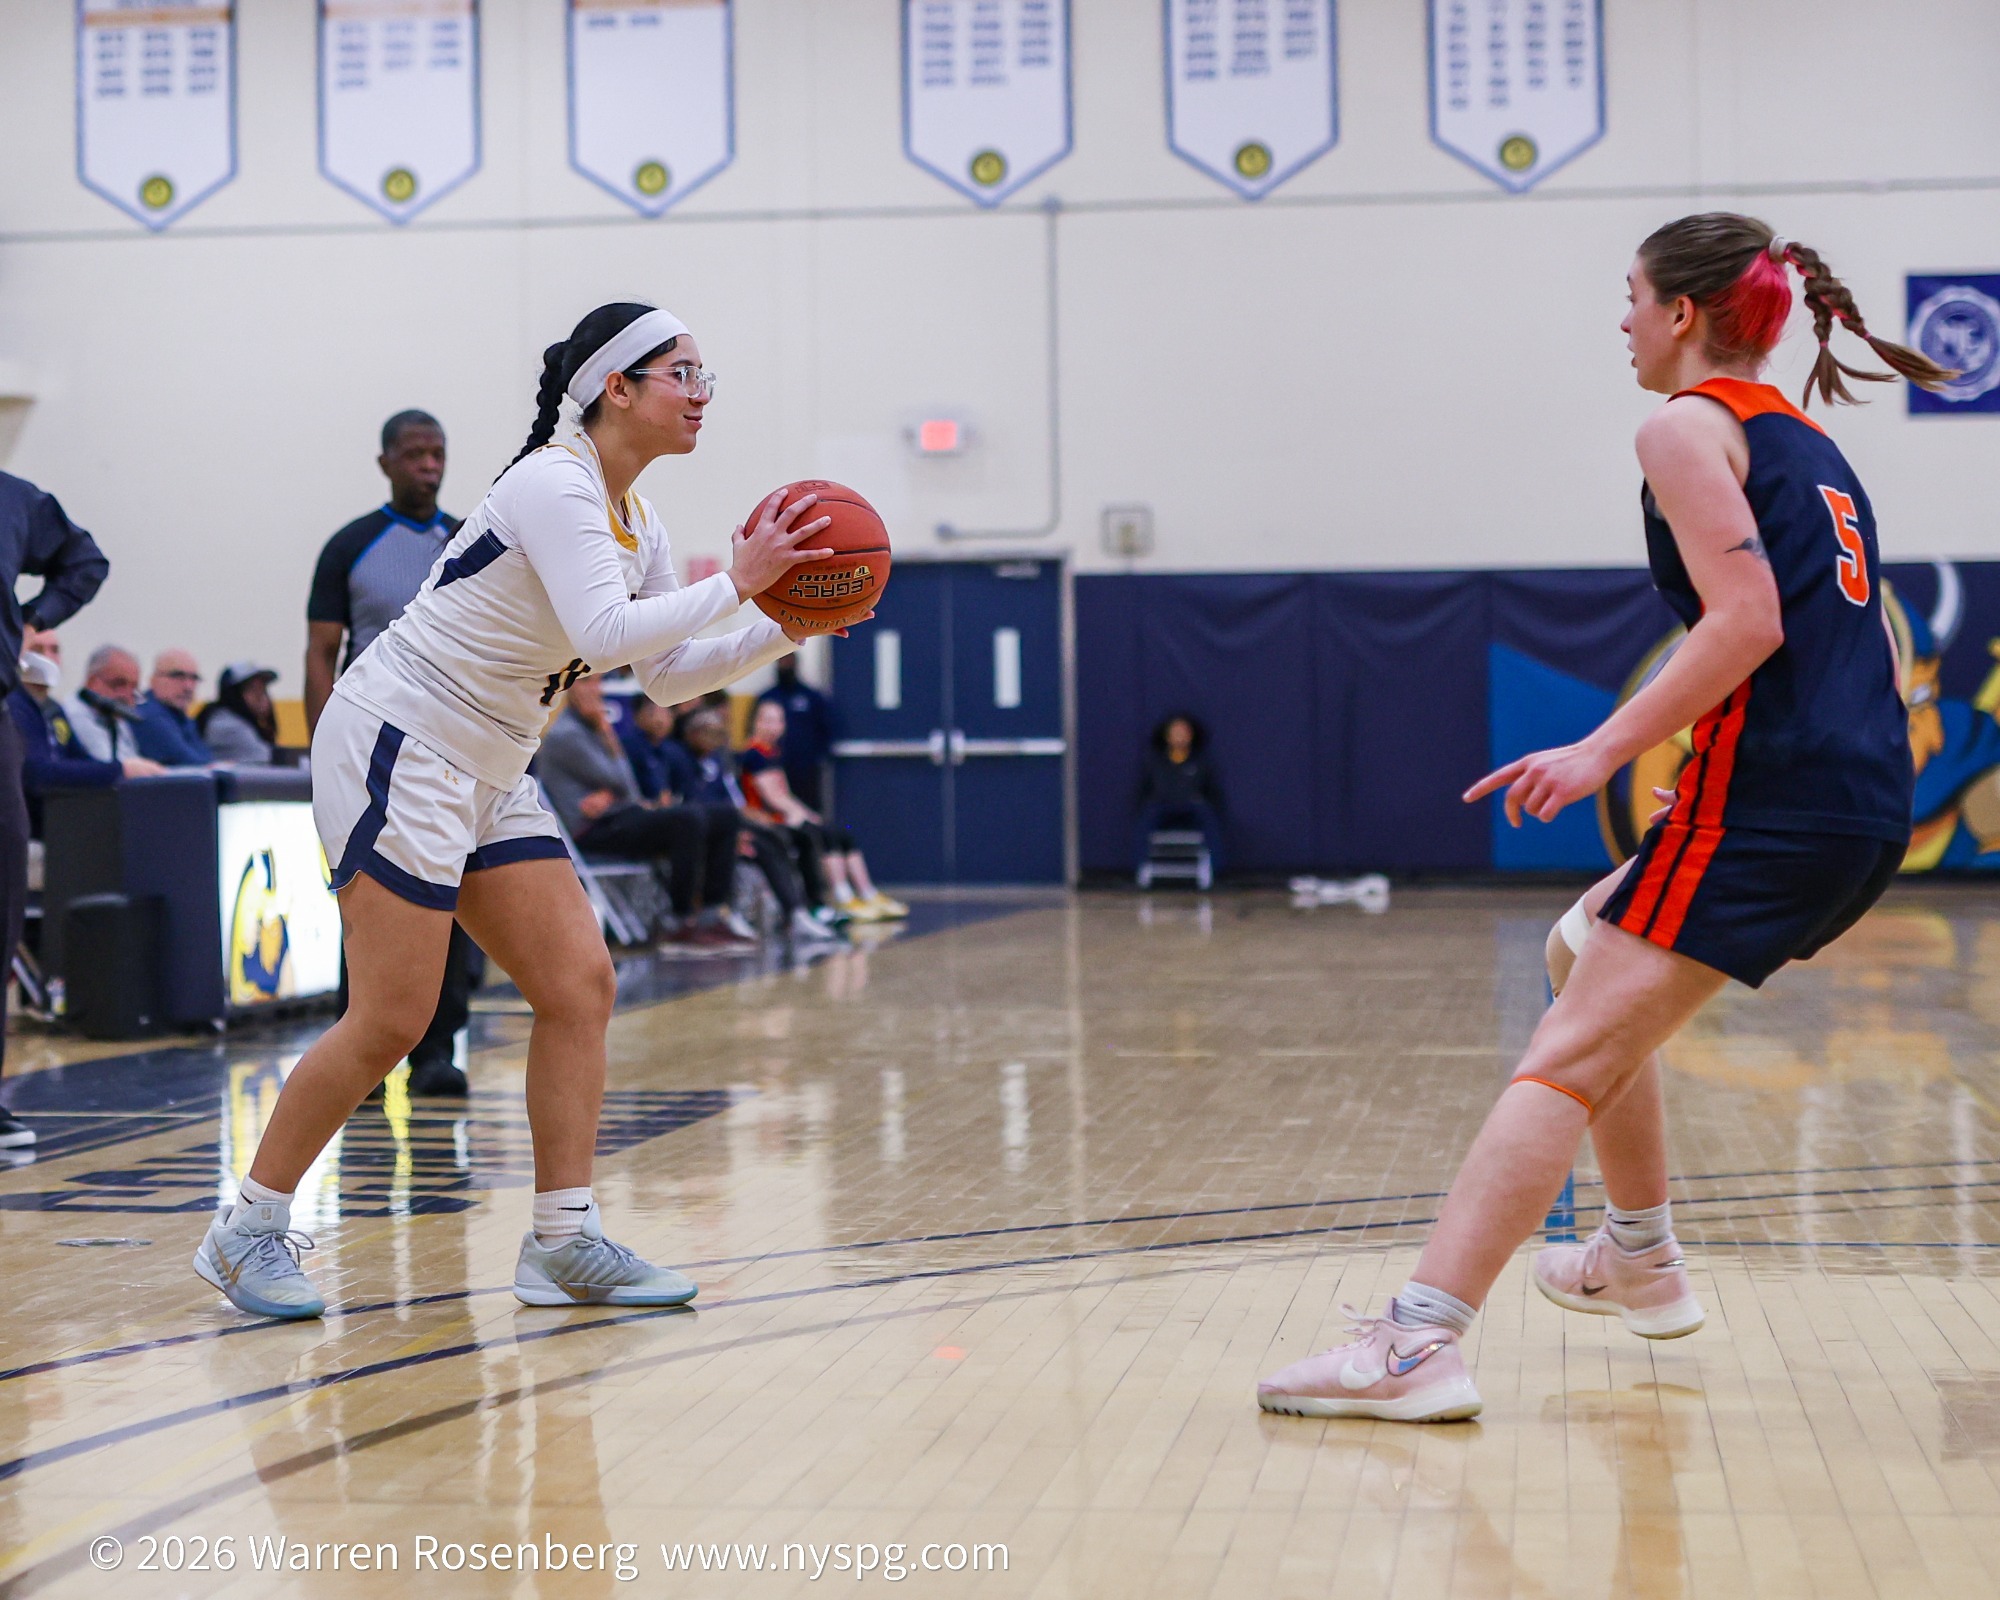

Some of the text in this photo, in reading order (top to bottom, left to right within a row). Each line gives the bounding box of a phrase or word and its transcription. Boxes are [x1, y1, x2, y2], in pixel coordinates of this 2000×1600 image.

[1817, 485, 1870, 607] 5
[788, 575, 875, 598] LEGACY
[796, 571, 852, 582] 1000
